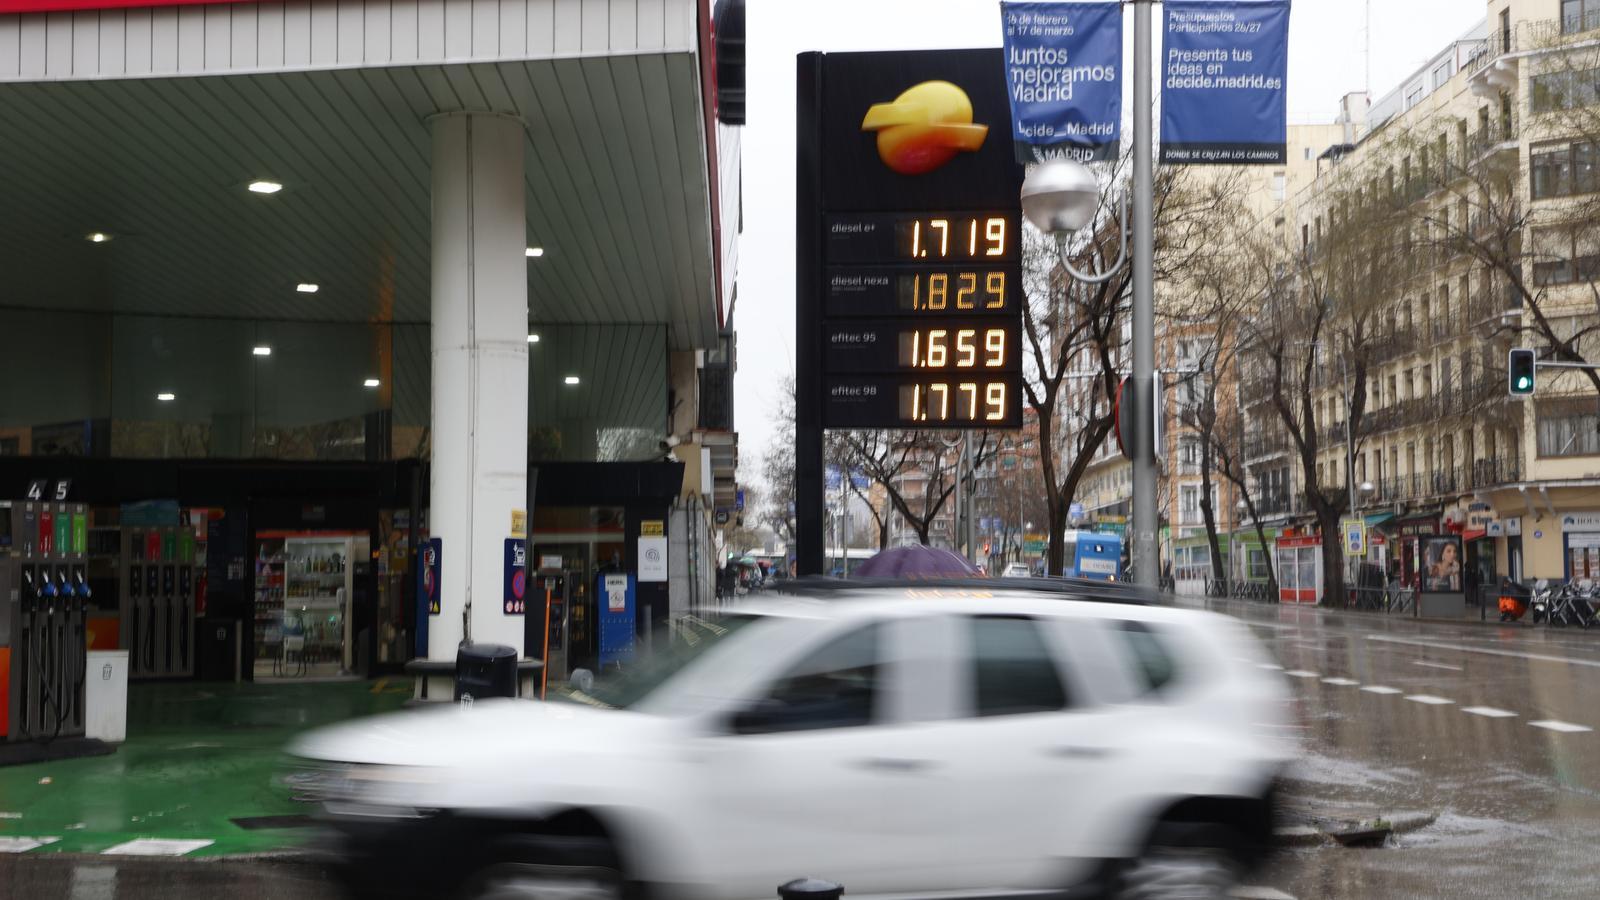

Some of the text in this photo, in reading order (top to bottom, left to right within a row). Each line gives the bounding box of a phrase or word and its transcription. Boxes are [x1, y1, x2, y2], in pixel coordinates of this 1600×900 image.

[1019, 14, 1031, 24] de
[1033, 14, 1068, 25] febrero
[1169, 11, 1235, 22] Presupuestos
[1007, 26, 1074, 36] al 17 de marzo
[1168, 22, 1261, 34] Participativos 26/27
[1010, 45, 1068, 65] Juntos
[1168, 48, 1253, 62] Presenta tus
[1167, 62, 1223, 76] ideas en
[1166, 74, 1282, 90] decide.madrid.es
[1044, 147, 1094, 163] MADRID
[1166, 150, 1280, 160] DONDE SE CRUZAN LOS CAMINOS
[831, 223, 862, 233] diesel
[912, 218, 1005, 257] 1.719
[831, 276, 889, 286] diesel nexa
[913, 271, 1005, 310] 1.829
[831, 332, 876, 343] efitec 95
[912, 329, 1005, 367] 1.659
[831, 386, 877, 396] efitec 98
[912, 383, 1005, 421] 1.779
[28, 482, 41, 500] 4
[56, 481, 67, 500] 5
